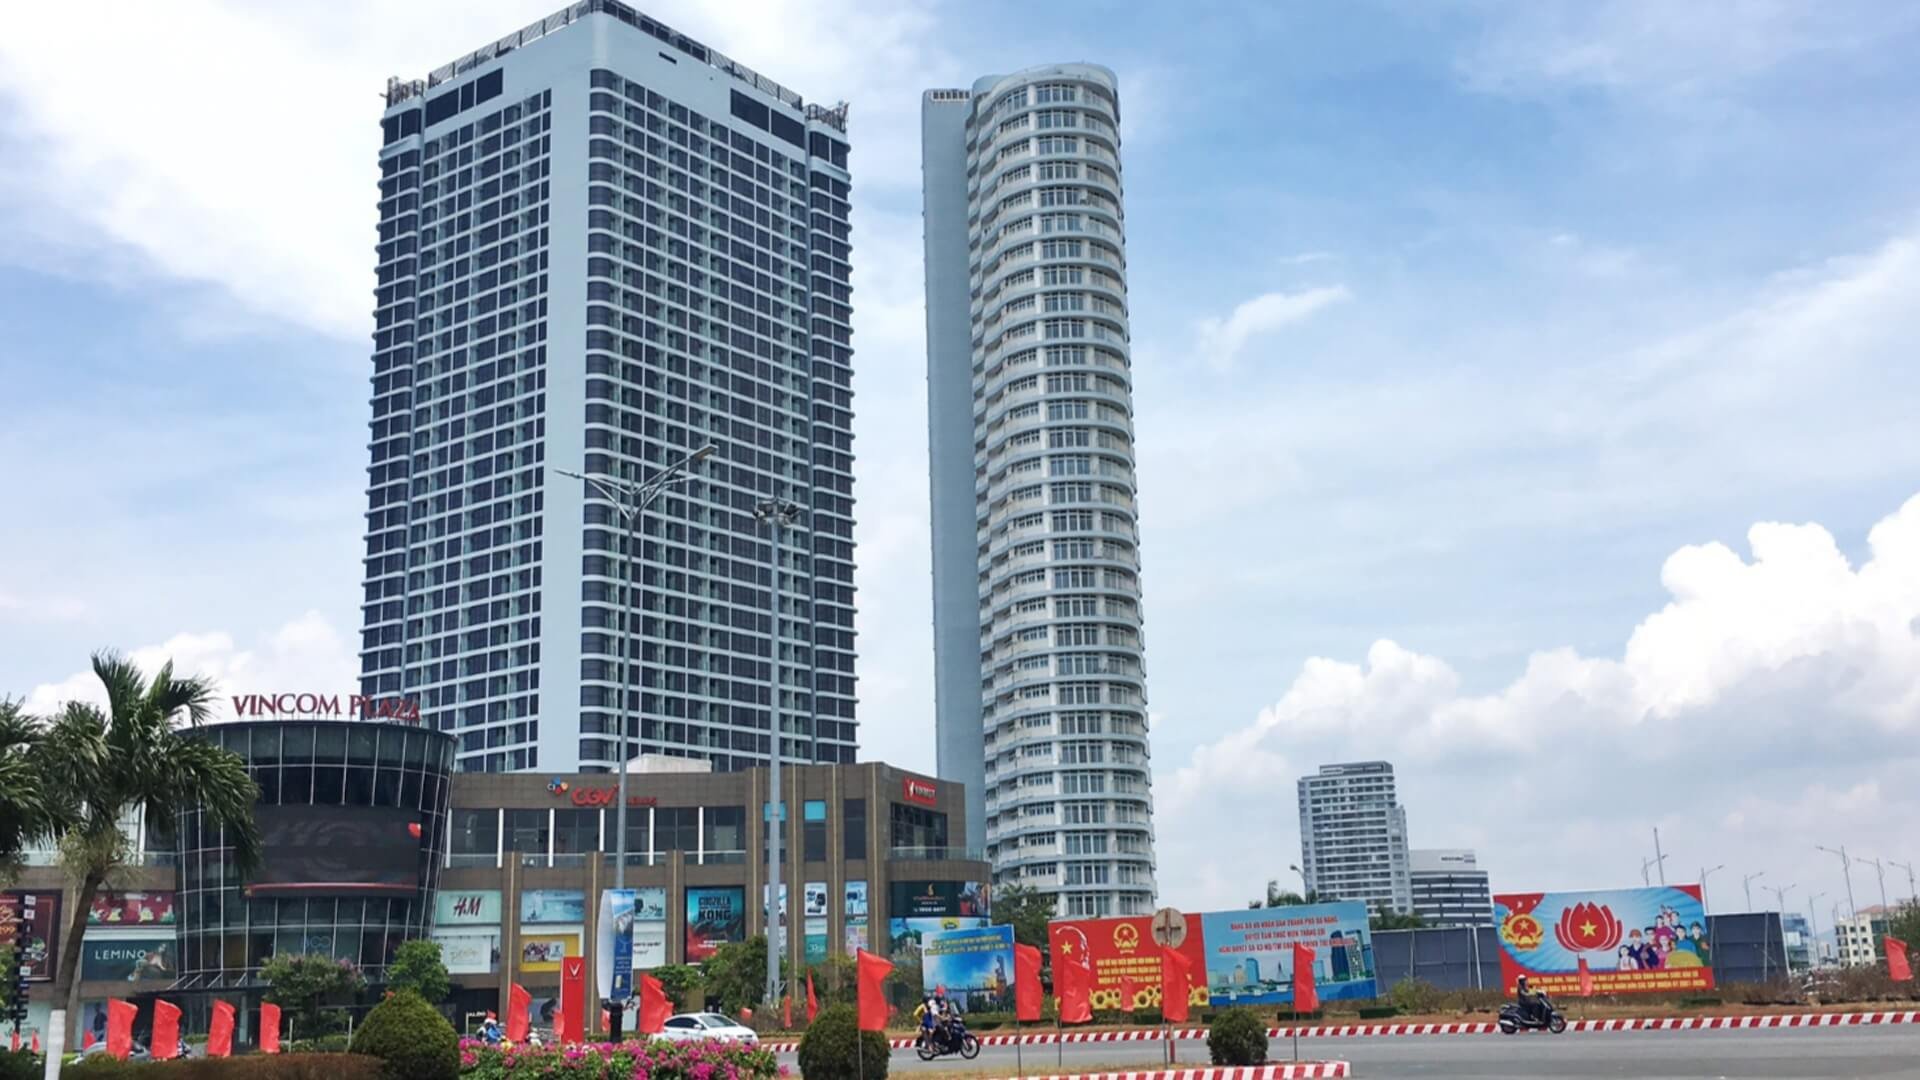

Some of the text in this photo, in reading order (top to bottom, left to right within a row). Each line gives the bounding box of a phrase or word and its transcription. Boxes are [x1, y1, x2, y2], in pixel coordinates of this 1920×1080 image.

[232, 693, 421, 721] VINCOM PLAZA
[572, 784, 619, 806] CGV
[698, 910, 731, 921] KONG
[95, 949, 147, 960] LEMINO
